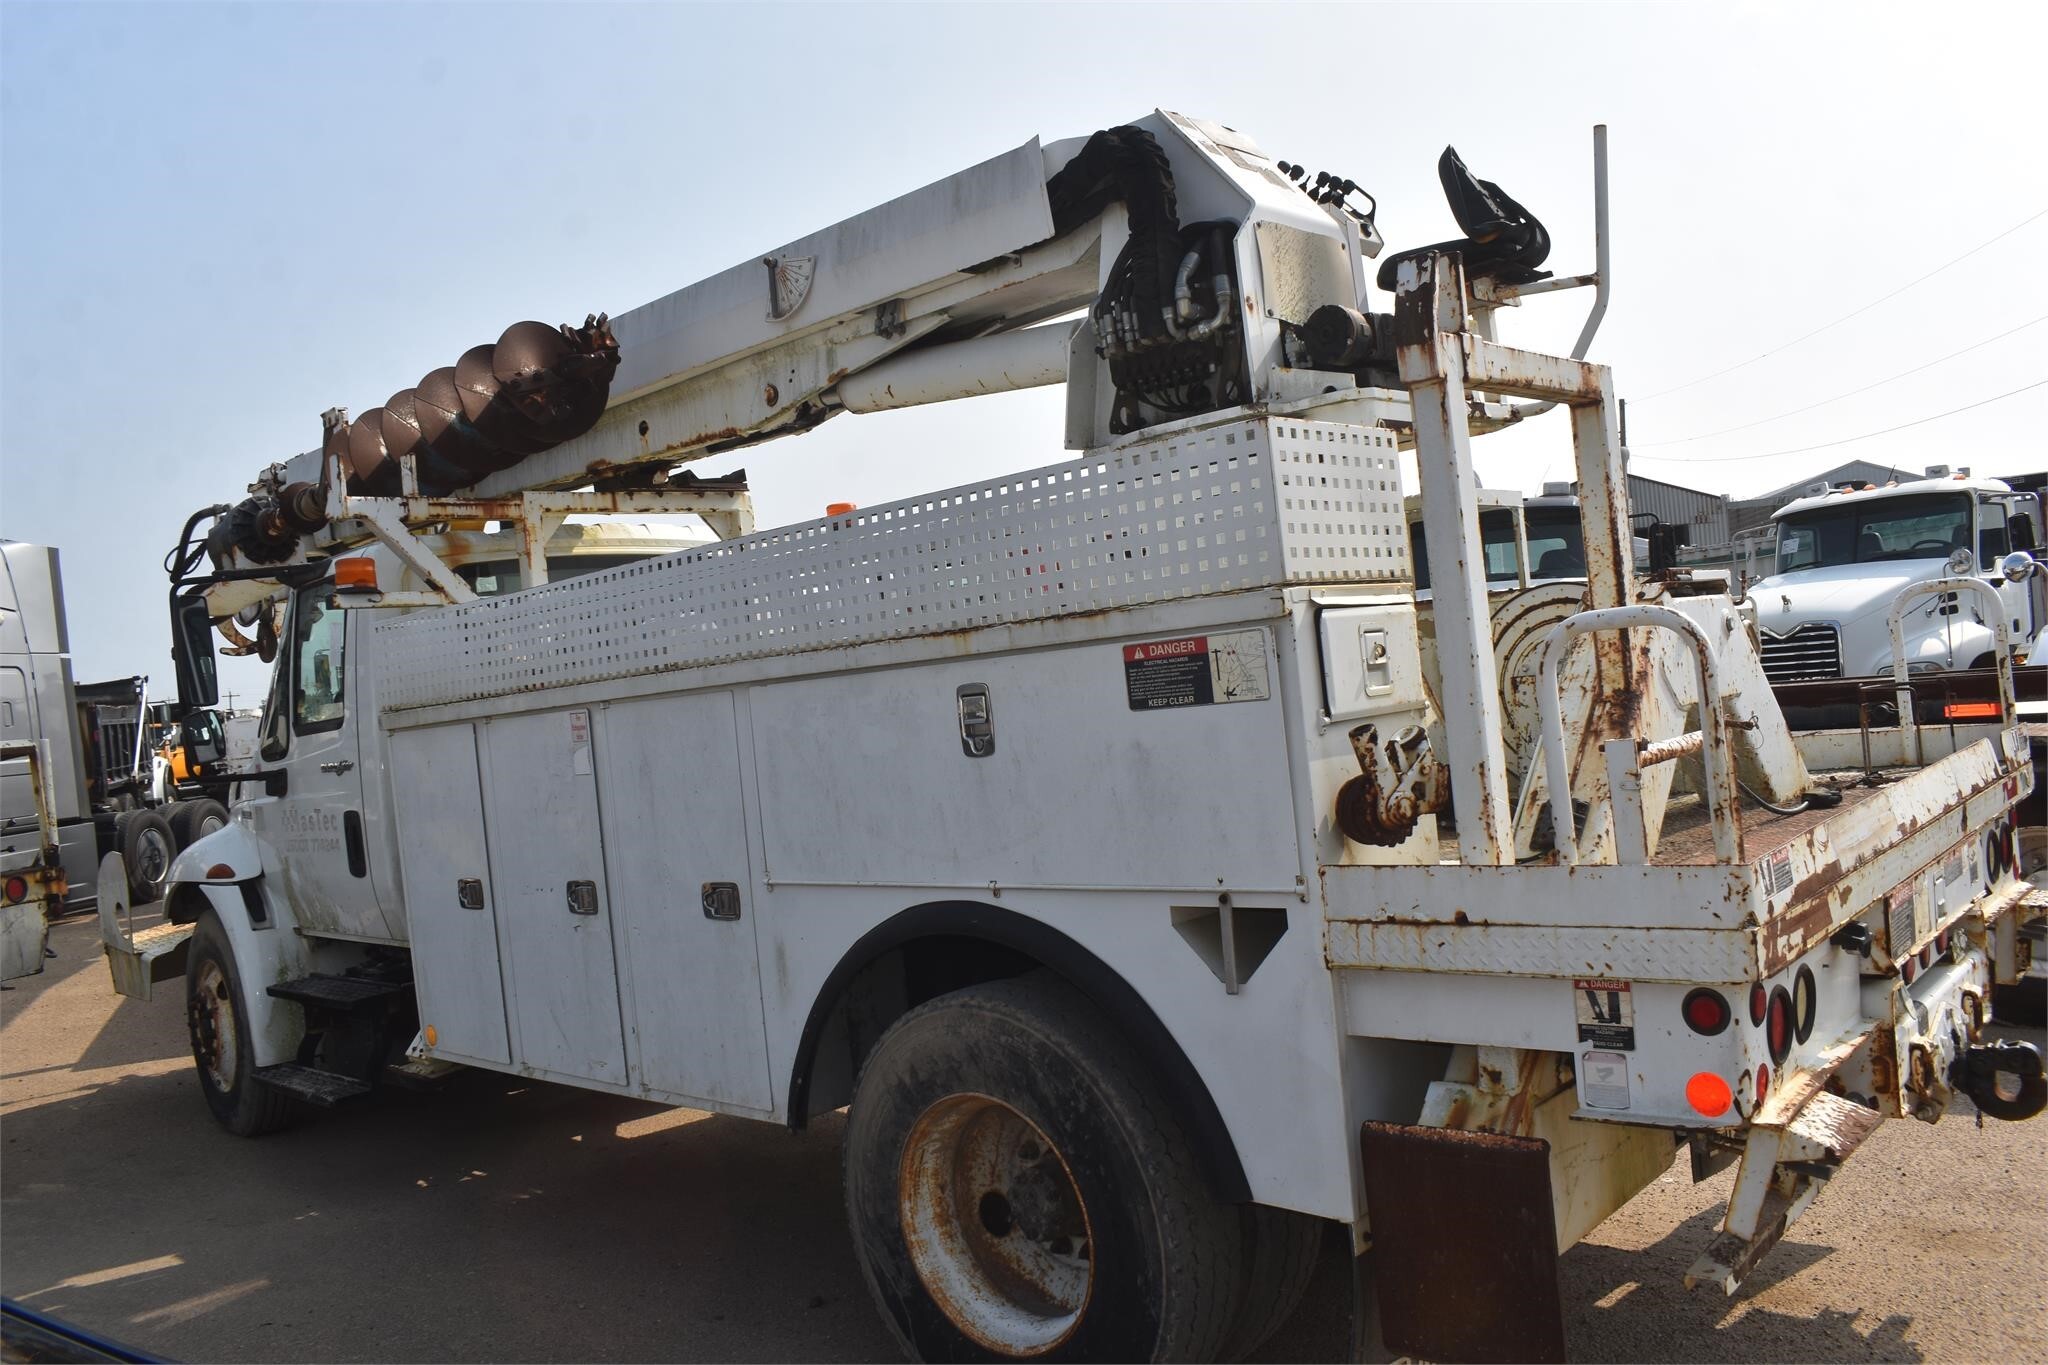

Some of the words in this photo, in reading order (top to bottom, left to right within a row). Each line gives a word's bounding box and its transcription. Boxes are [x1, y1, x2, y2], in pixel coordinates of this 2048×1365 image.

[1149, 641, 1196, 656] DANGER
[1148, 697, 1168, 707] KEEP
[1169, 695, 1195, 705] CLEAR
[1590, 979, 1625, 989] DANGER
